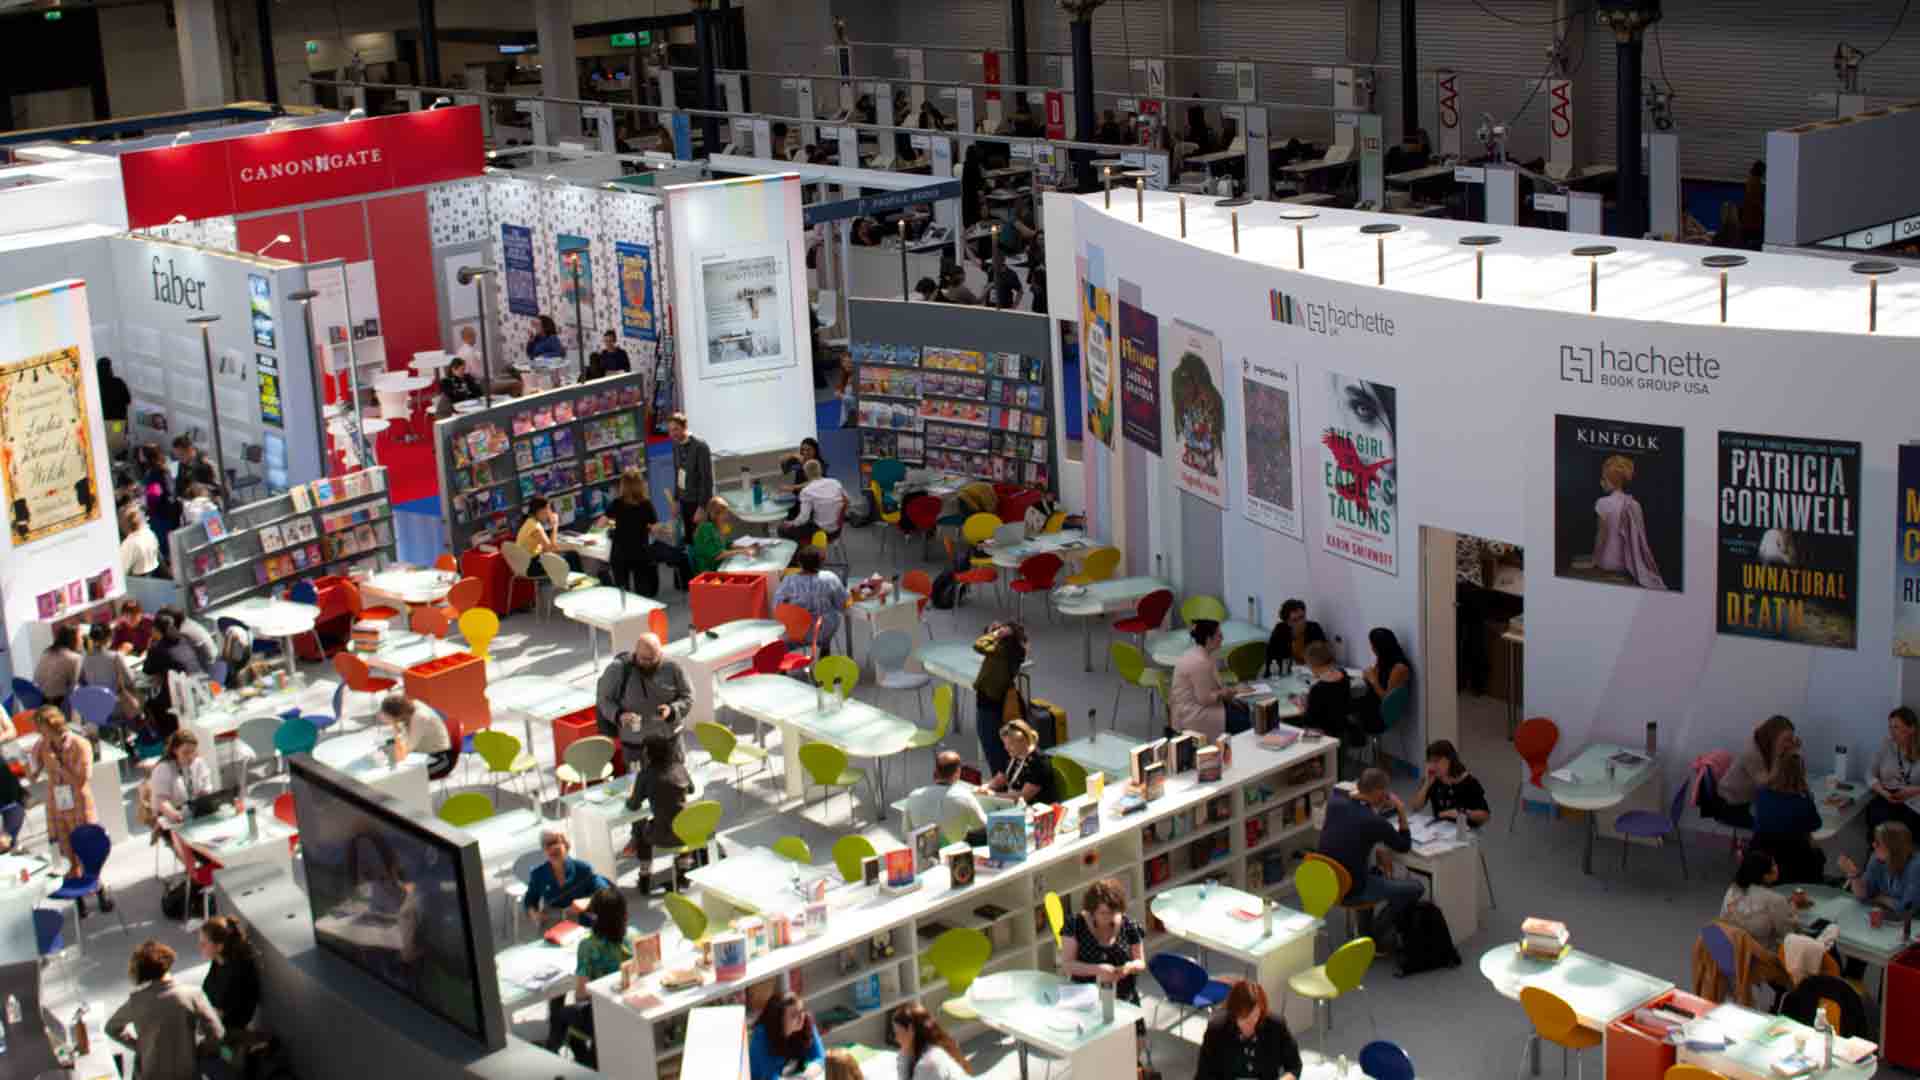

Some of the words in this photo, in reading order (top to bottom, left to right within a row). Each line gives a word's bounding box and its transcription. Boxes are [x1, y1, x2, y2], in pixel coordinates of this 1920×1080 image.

[1440, 75, 1458, 129] CAA
[1552, 81, 1570, 138] CAA
[240, 148, 383, 183] CANONGATE
[151, 255, 206, 311] faber
[1327, 301, 1394, 337] hachette
[1600, 340, 1721, 380] hachette
[1600, 373, 1634, 388] BOOK
[1637, 377, 1681, 393] GROUP
[1684, 382, 1711, 395] USA
[1356, 432, 1386, 459] GIRL
[1576, 427, 1659, 450] KINFOLK
[1731, 448, 1846, 496] PATRICIA
[1327, 493, 1391, 535] TALONS
[1721, 486, 1855, 536] CORNWELL
[1742, 563, 1848, 600] UNNATURAL
[1726, 591, 1805, 633] DEATH
